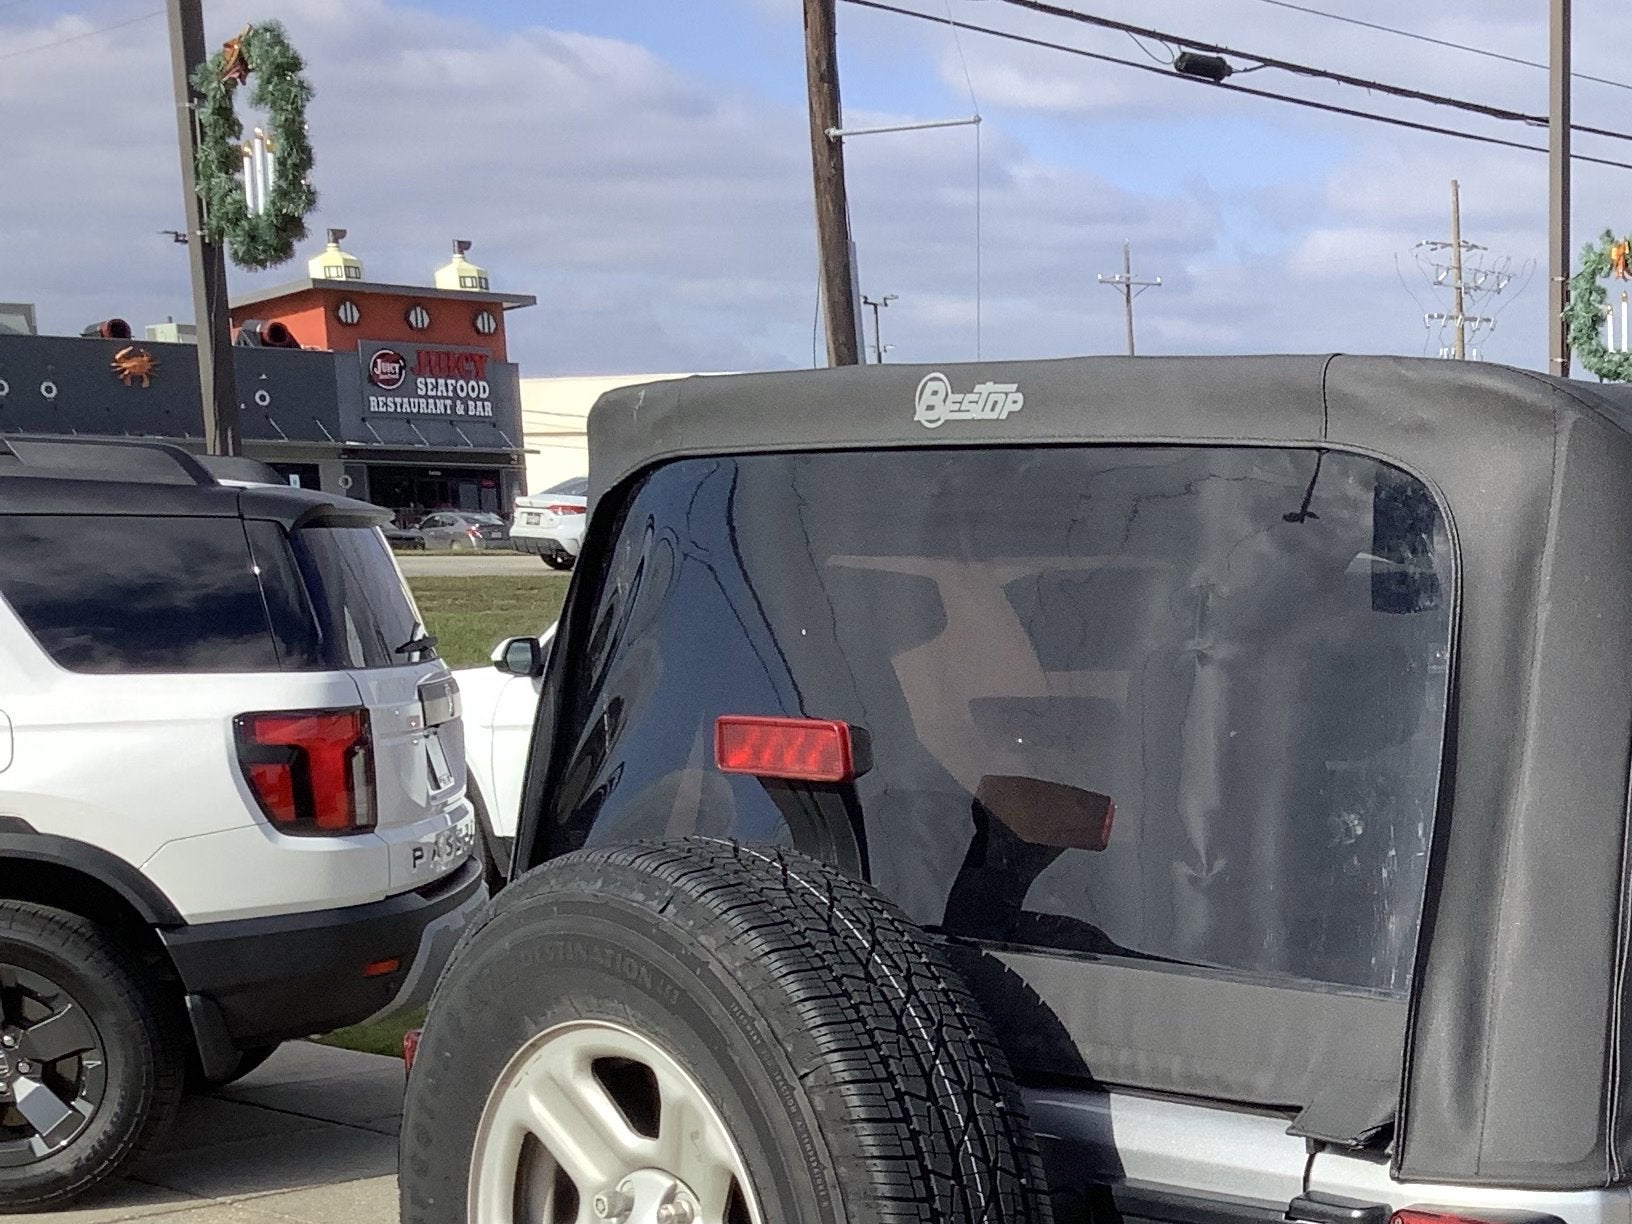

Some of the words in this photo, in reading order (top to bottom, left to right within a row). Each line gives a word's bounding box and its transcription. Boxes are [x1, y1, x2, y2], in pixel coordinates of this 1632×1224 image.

[411, 349, 488, 380] JUICY
[416, 377, 490, 399] SEAFOOD
[369, 396, 452, 414] RESTAURANT
[455, 401, 465, 416] &
[467, 401, 493, 417] BAR
